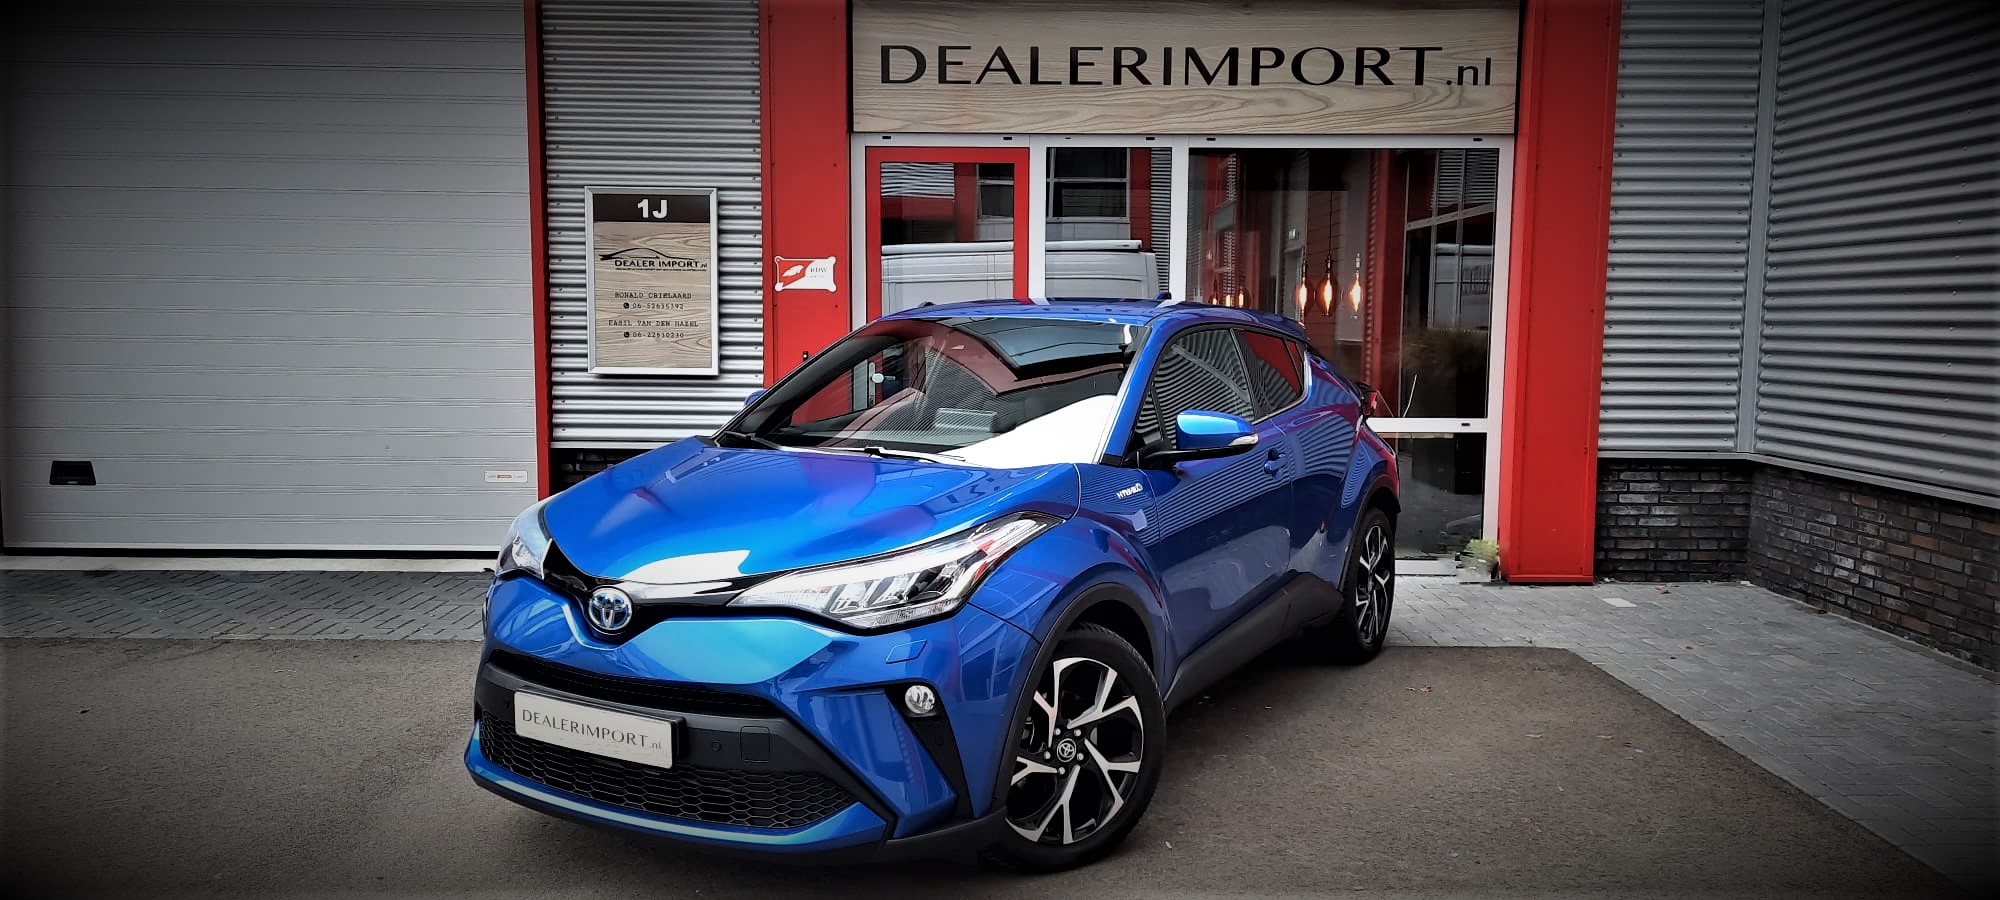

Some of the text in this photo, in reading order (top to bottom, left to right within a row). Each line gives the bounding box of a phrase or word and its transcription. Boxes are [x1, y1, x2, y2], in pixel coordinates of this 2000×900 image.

[880, 44, 1491, 87] DEALERIMPORT.nl
[637, 198, 668, 219] 1J
[614, 259, 655, 268] DEALER
[522, 709, 662, 750] DEALERIMPORT.nl
